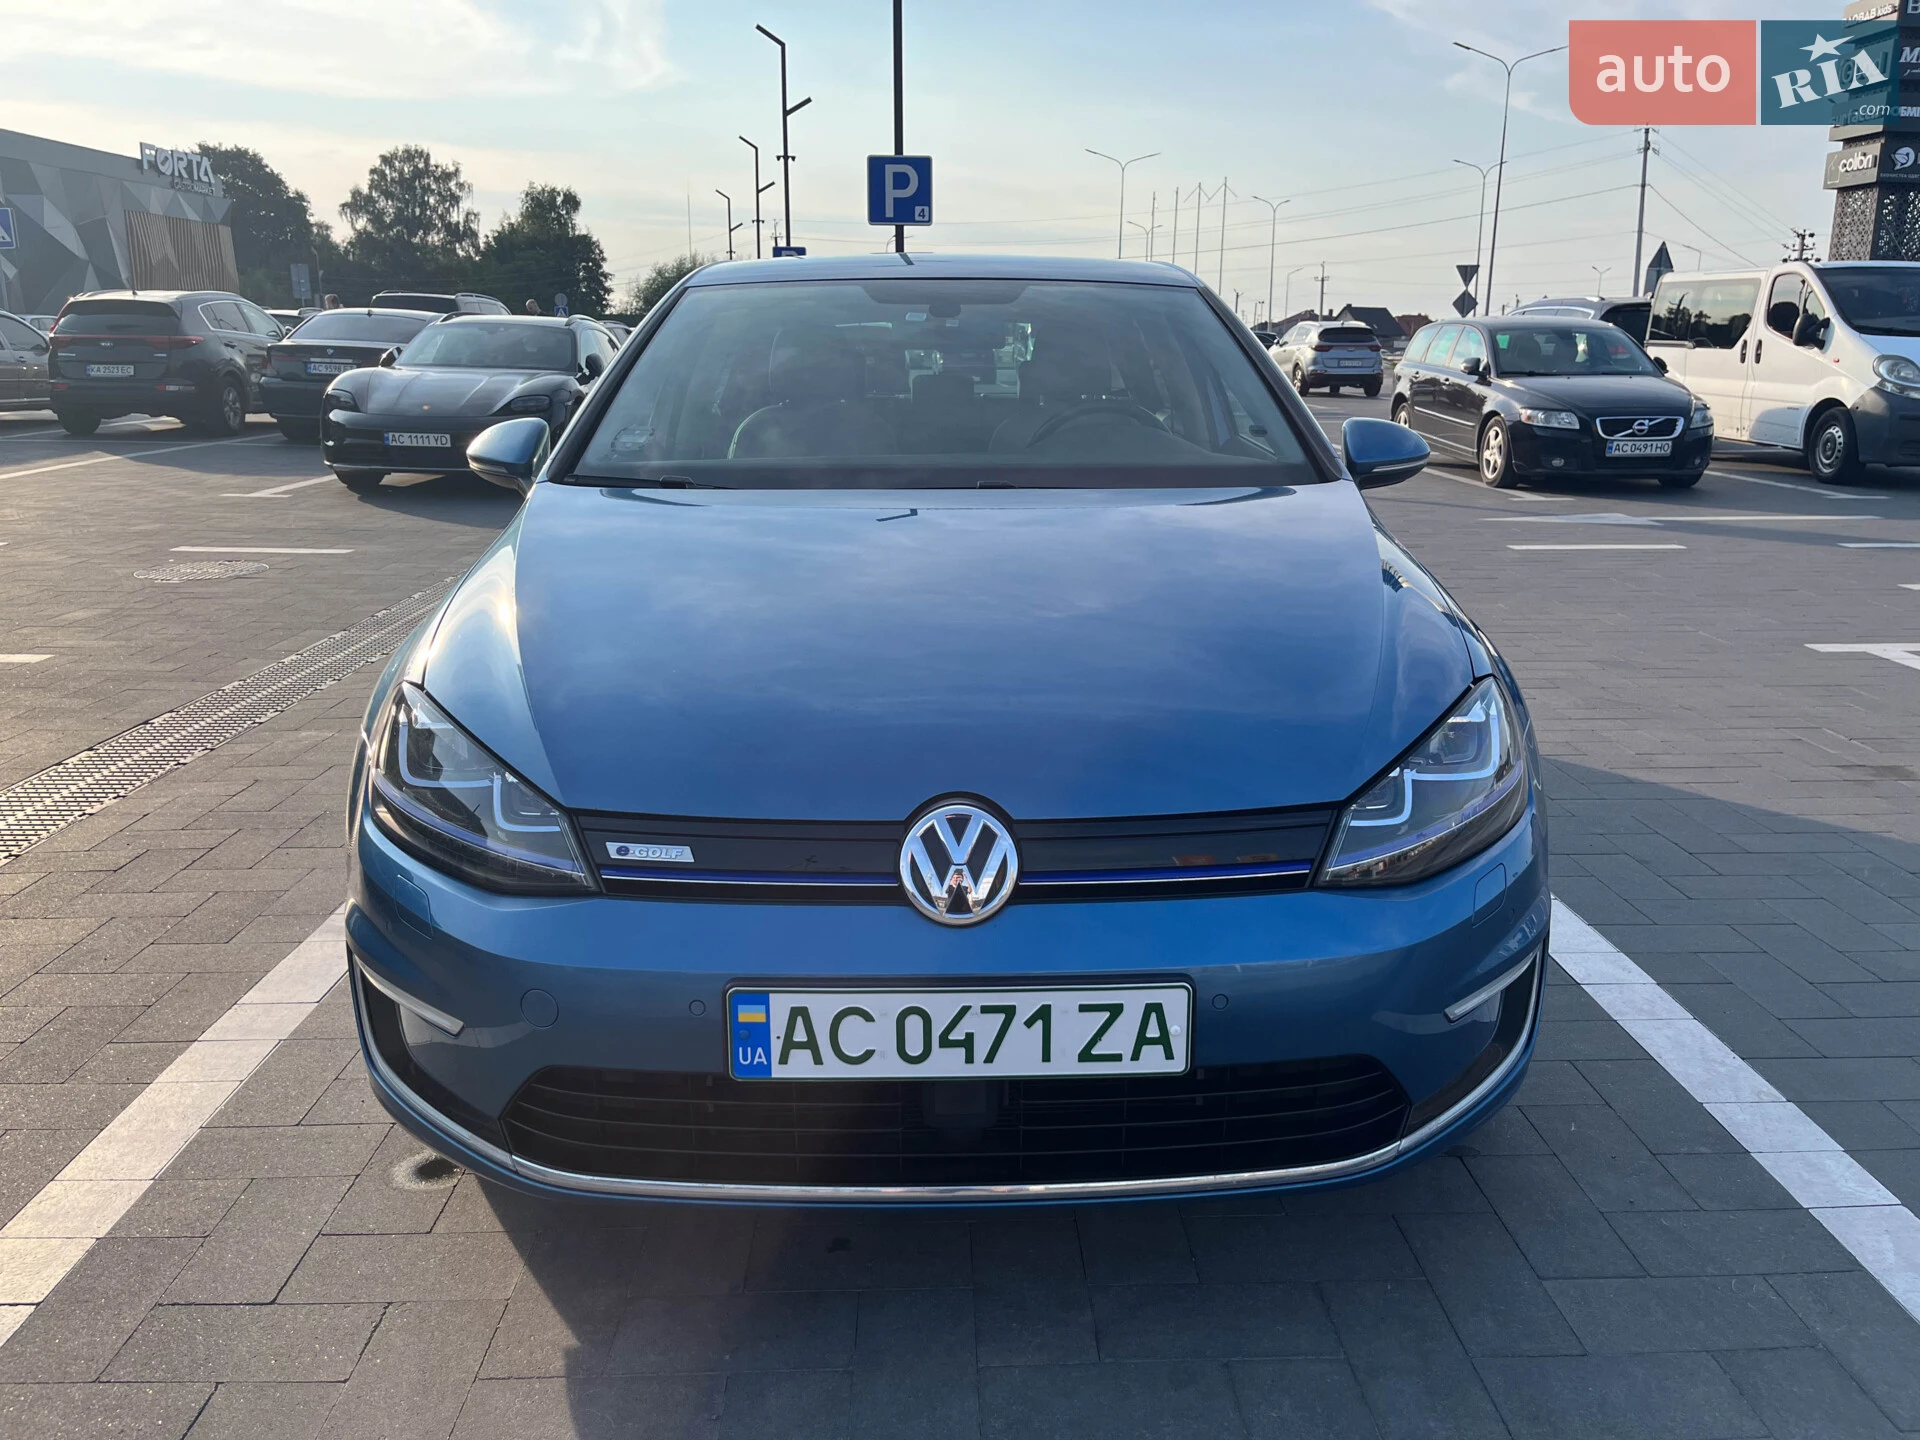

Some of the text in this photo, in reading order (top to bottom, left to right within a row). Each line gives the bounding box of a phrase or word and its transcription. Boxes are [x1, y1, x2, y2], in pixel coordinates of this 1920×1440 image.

[885, 164, 919, 218] P
[918, 208, 926, 219] 4
[90, 366, 132, 374] KA 2523 EC
[390, 434, 448, 446] AC 1111 YD
[1613, 442, 1670, 453] AC 0491 HO
[616, 845, 684, 859] e-GOLF
[738, 1002, 1176, 1066] UA AC 0471 ZA
